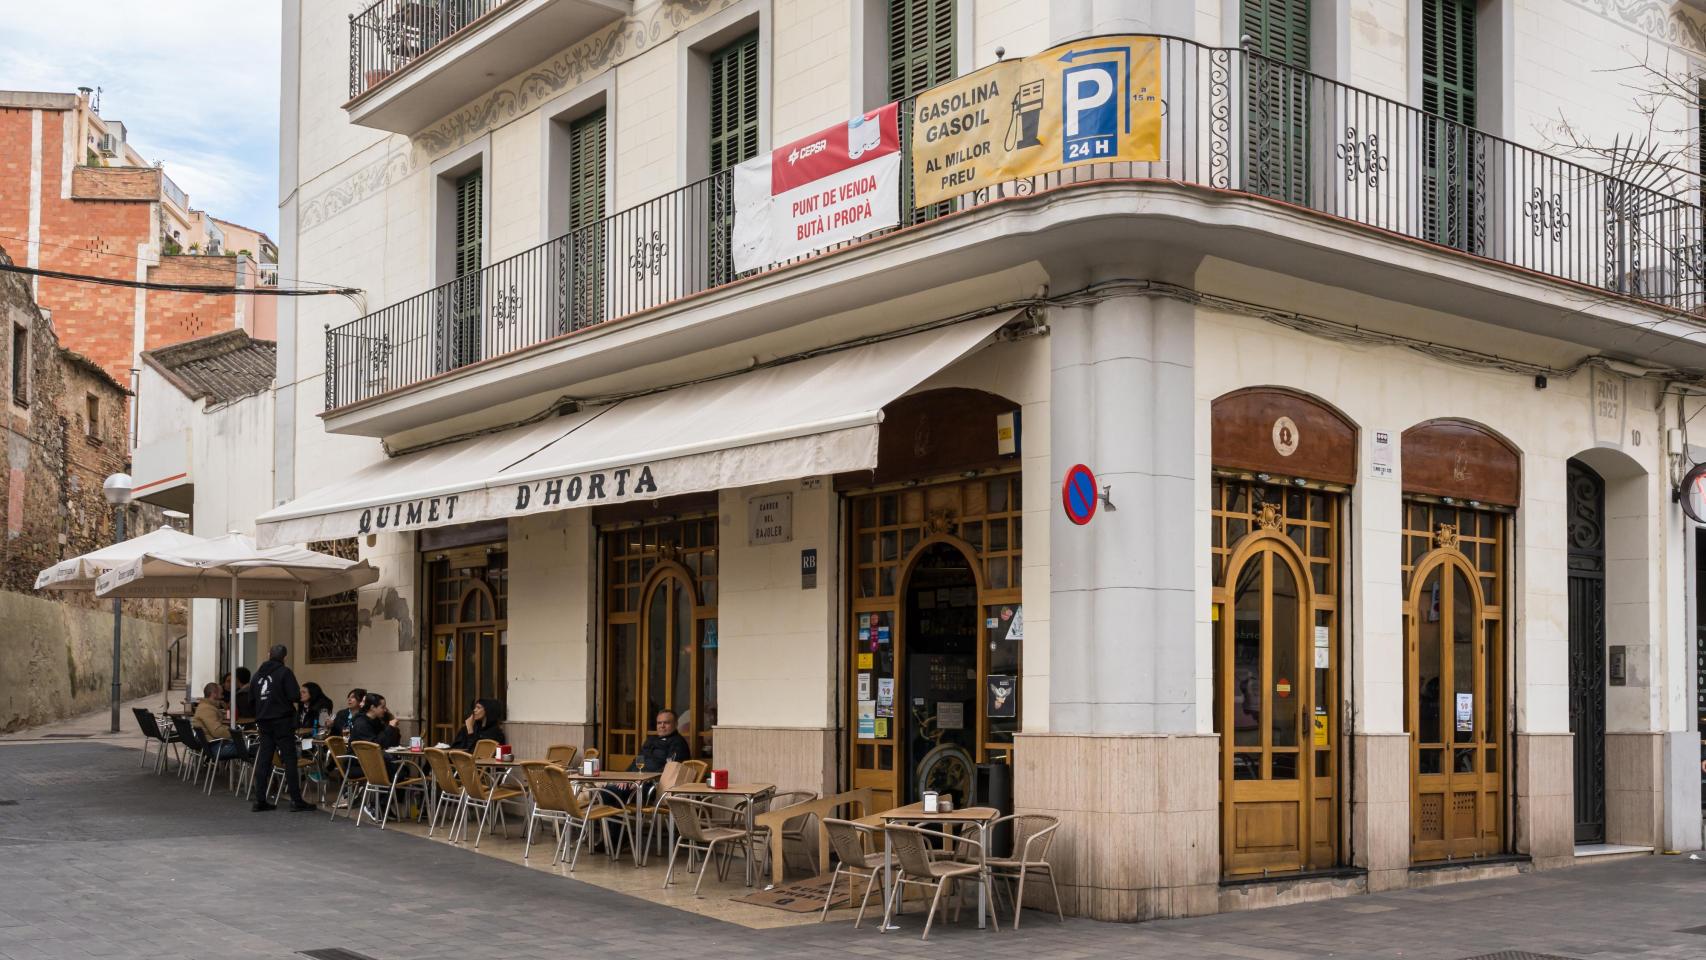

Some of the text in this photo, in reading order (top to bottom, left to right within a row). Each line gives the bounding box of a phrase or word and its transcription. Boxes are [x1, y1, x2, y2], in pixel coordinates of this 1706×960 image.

[919, 80, 1000, 124] GASOLINA
[1066, 68, 1113, 136] P
[926, 109, 990, 143] GASOIL
[800, 139, 827, 159] CEPSA
[926, 141, 991, 173] AL MILLOR
[1069, 140, 1109, 159] 24 H
[941, 167, 975, 189] PREU
[793, 175, 877, 218] PUNT DE VENDA
[797, 198, 872, 241] BUTÀ I PROPÀ
[1631, 429, 1641, 447] 10
[358, 465, 658, 534] QUIMET D'HORTA
[803, 555, 816, 569] RB
